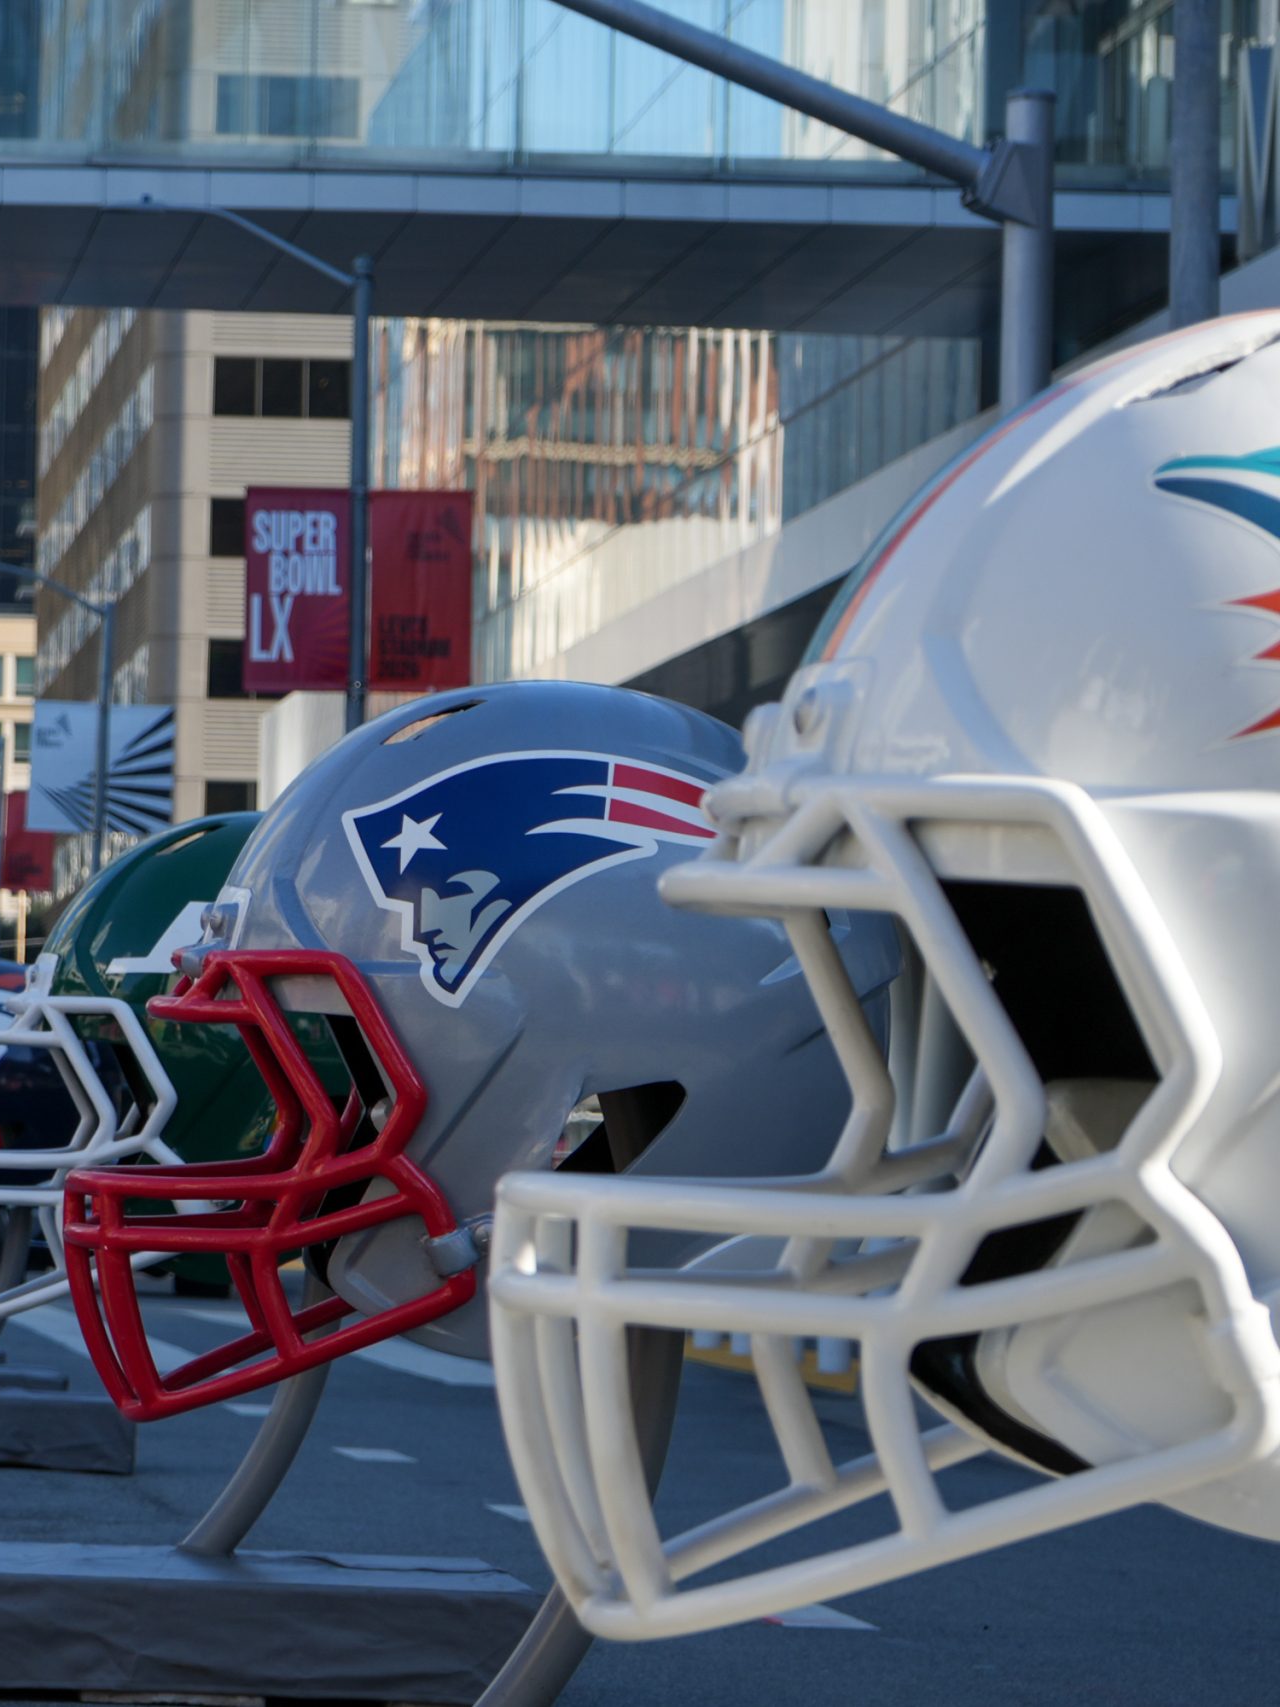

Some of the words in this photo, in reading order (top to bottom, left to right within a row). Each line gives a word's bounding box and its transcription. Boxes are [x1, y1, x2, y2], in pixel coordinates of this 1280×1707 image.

[252, 509, 338, 554] SUPER
[268, 552, 342, 596] BOWL
[249, 593, 294, 663] LX
